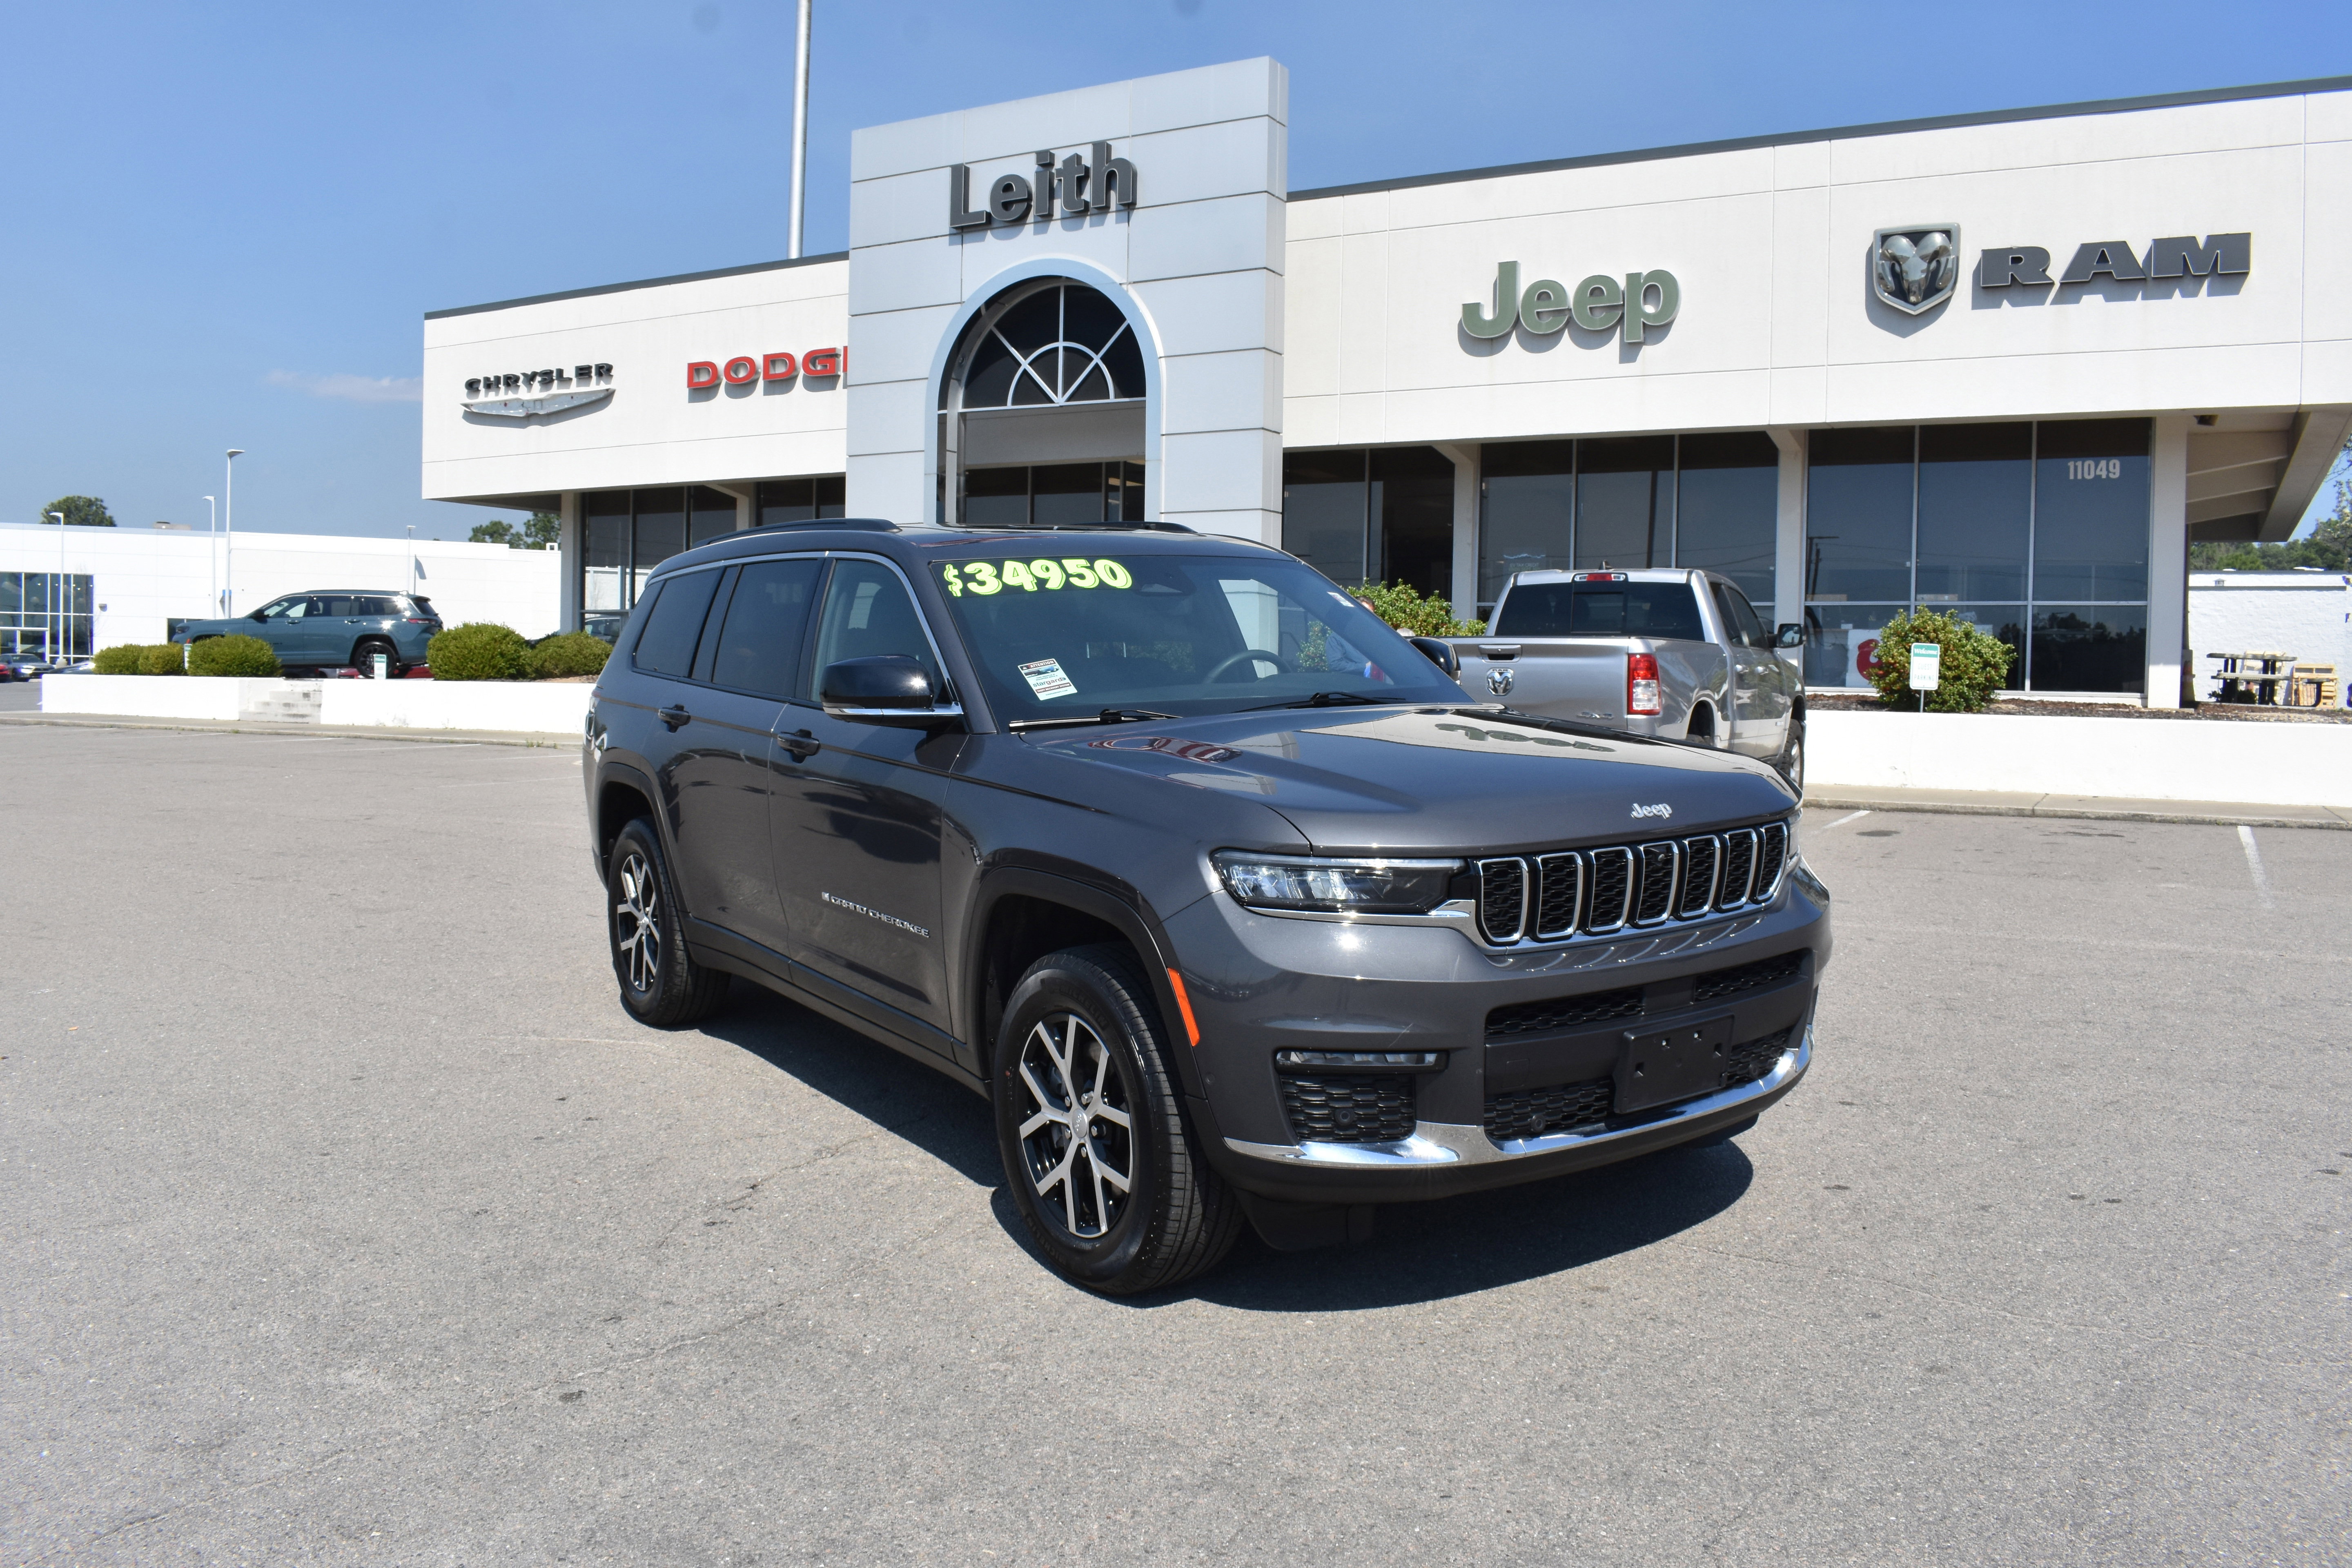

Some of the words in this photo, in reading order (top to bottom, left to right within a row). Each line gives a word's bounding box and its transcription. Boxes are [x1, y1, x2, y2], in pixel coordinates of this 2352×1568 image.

[950, 141, 1137, 229] Leith
[1980, 232, 2251, 289] RAM
[1461, 261, 1681, 343] Jeep
[465, 362, 614, 392] CHRYSLER
[686, 345, 848, 389] DODG
[2068, 459, 2120, 479] 11049
[944, 559, 1131, 597] $34950
[1630, 803, 1673, 819] Jeep
[831, 896, 867, 914] GRAND
[869, 909, 931, 938] CHEROKEE
